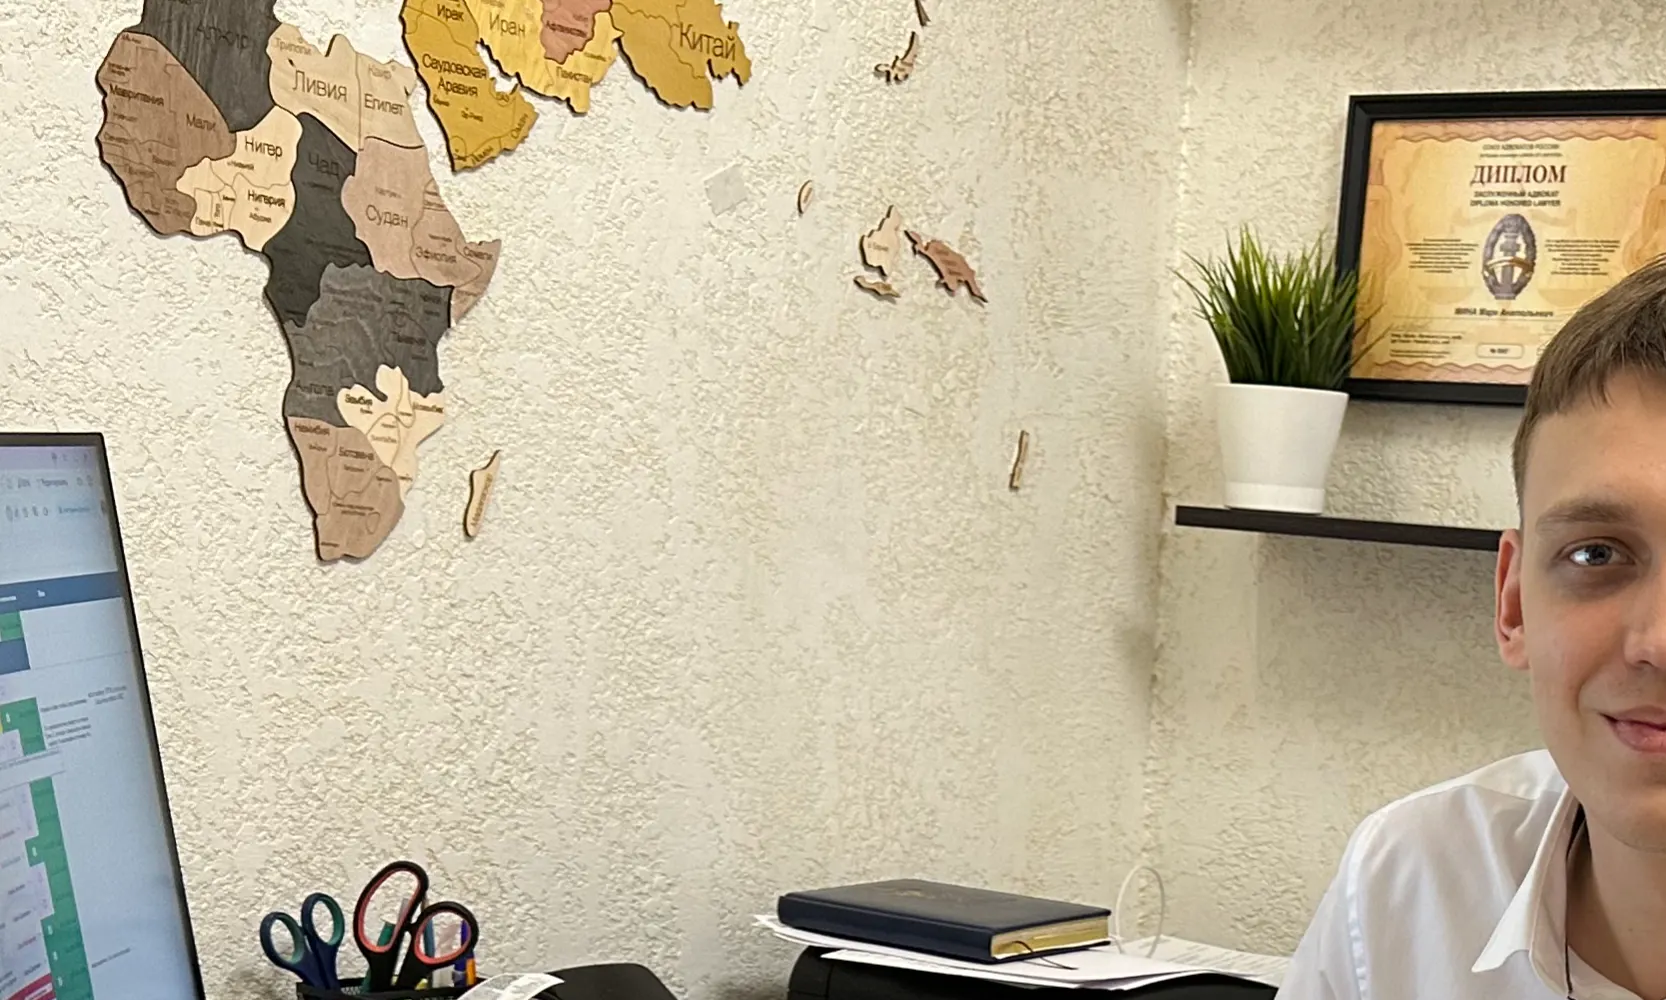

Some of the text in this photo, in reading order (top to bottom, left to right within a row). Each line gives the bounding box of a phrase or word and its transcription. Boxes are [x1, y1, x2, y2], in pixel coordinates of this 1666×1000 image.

[437, 4, 464, 22] Ирак
[489, 12, 526, 37] Иран
[679, 22, 736, 61] Китай
[421, 53, 488, 80] Саудовская
[109, 83, 165, 107] Мавритания
[292, 70, 347, 102] Ливия
[438, 77, 479, 97] Аравия
[364, 93, 405, 117] Египет
[186, 113, 216, 132] Мали
[245, 136, 283, 161] Нигер
[308, 151, 341, 178] Чад
[1470, 164, 1568, 187] ДИПЛОМ
[248, 188, 286, 209] Нигерия
[365, 204, 409, 229] Судан
[415, 246, 457, 265] Эфиопия
